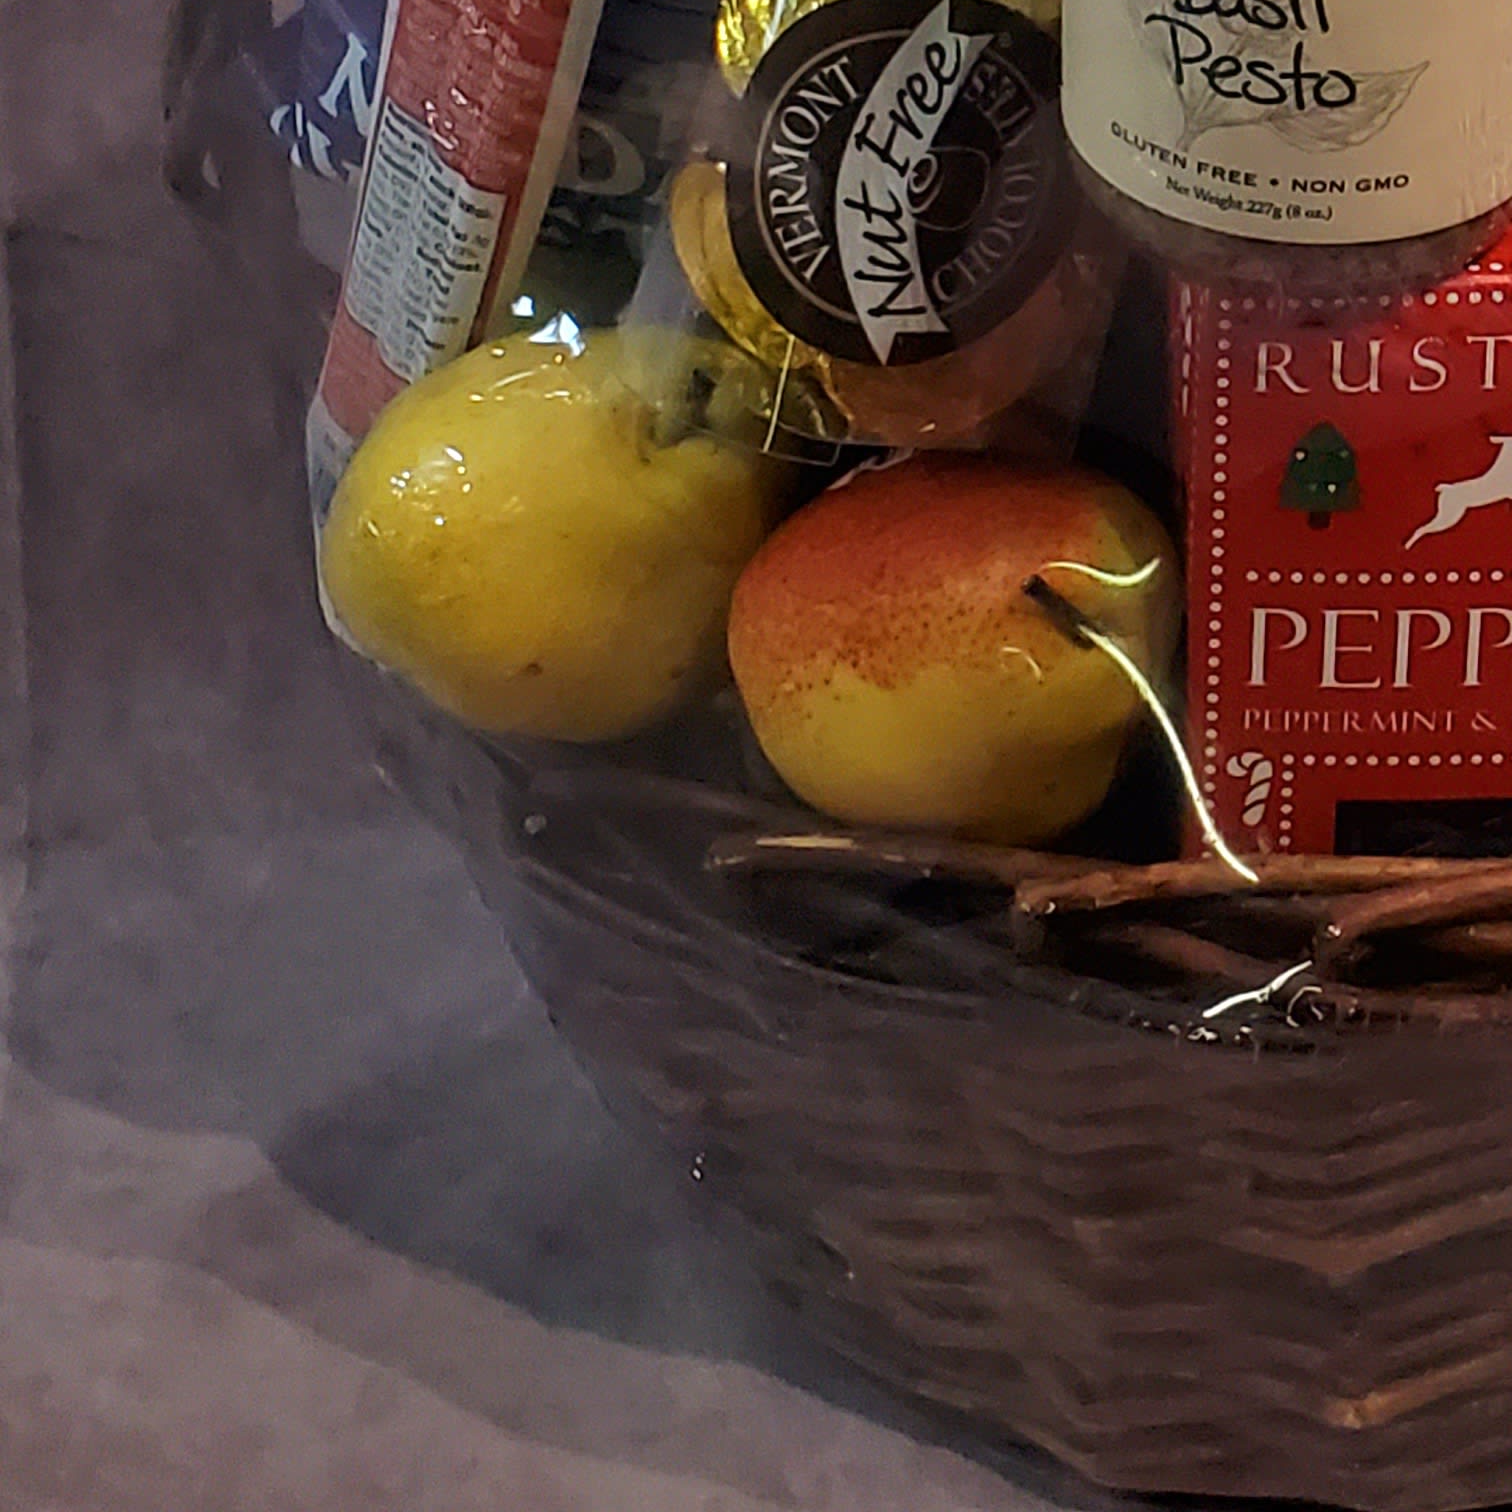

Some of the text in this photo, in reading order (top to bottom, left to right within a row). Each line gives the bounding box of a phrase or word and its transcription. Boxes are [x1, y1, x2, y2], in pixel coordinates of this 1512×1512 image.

[1145, 14, 1358, 111] Pesto
[767, 56, 863, 282] VERMONT
[844, 37, 962, 318] Nut Free
[1110, 120, 1410, 194] GLUTEN FREE NON GMO
[1193, 188, 1243, 211] Weight
[1246, 199, 1283, 220] 227g
[1243, 707, 1456, 734] PEPPERMINT
[1469, 710, 1498, 732] &
